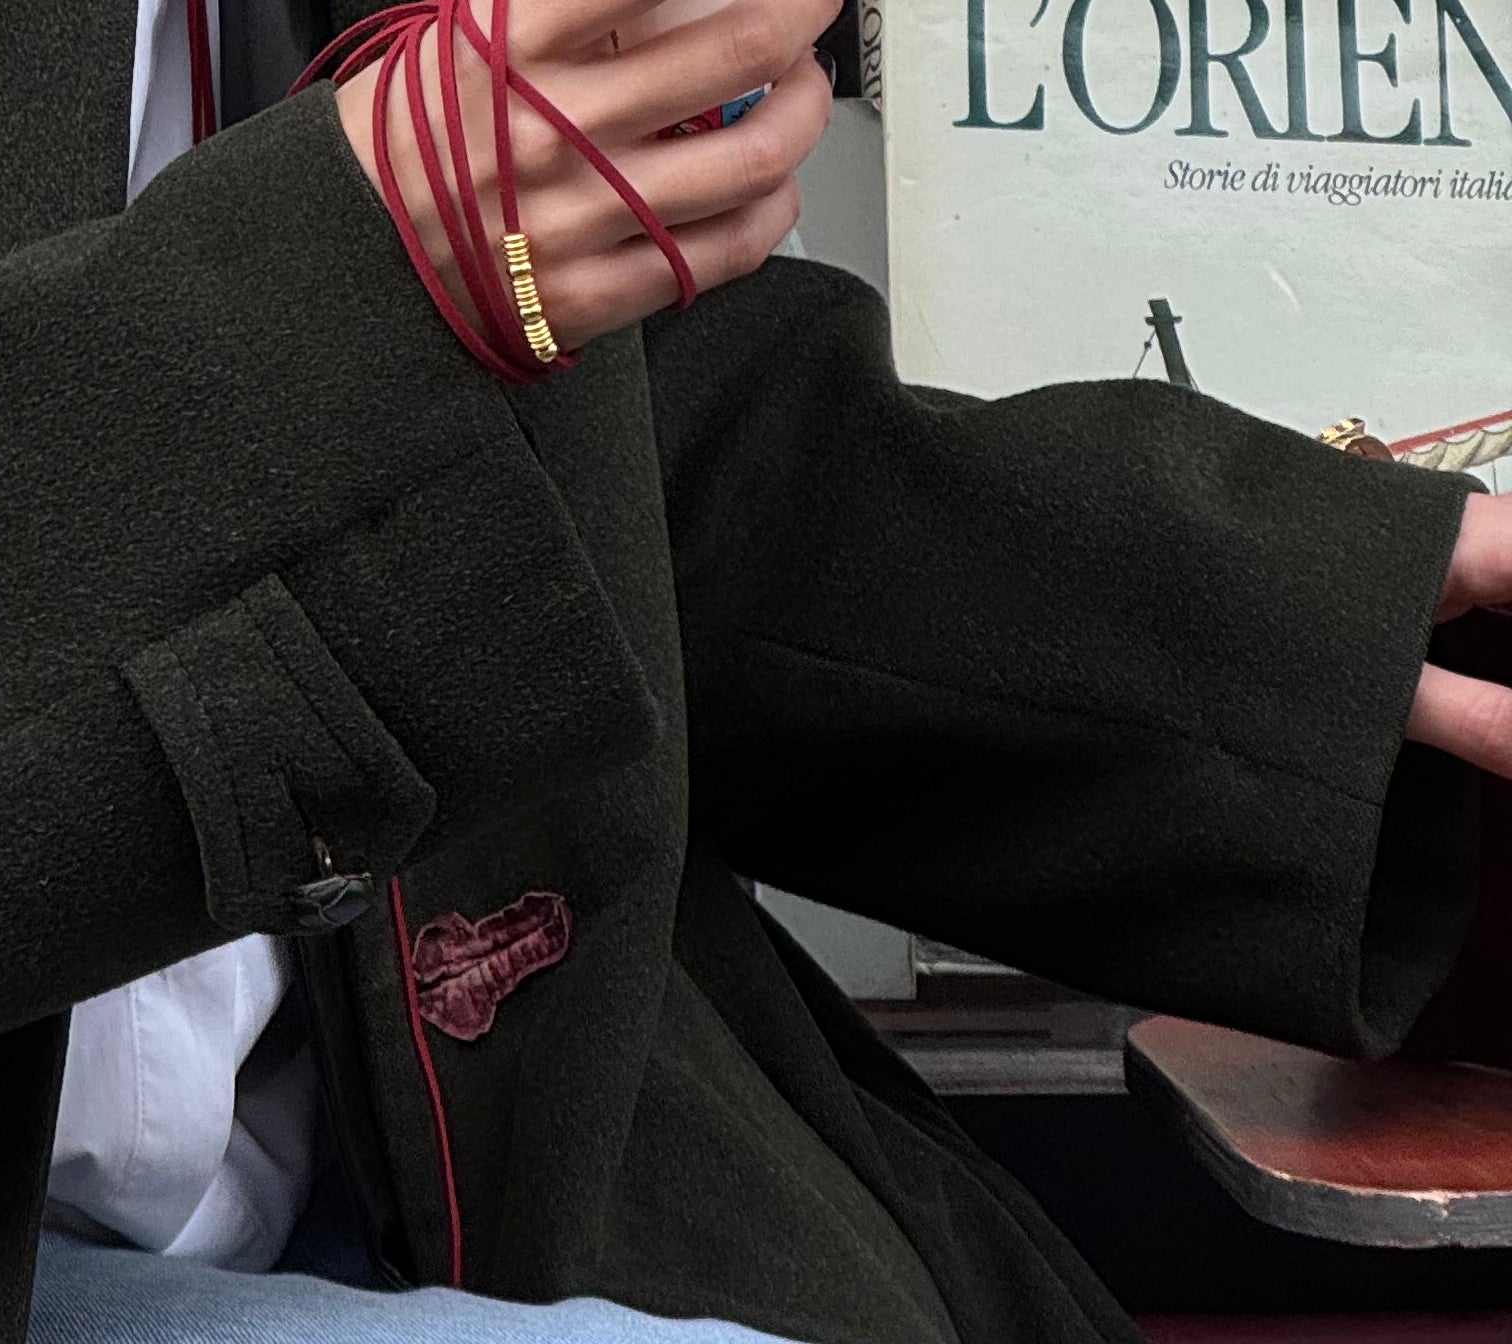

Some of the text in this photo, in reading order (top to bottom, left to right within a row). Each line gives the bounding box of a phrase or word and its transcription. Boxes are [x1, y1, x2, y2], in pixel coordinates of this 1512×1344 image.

[1164, 159, 1245, 192] Storie
[1251, 162, 1281, 193] di
[1286, 165, 1443, 207] viaggiatori
